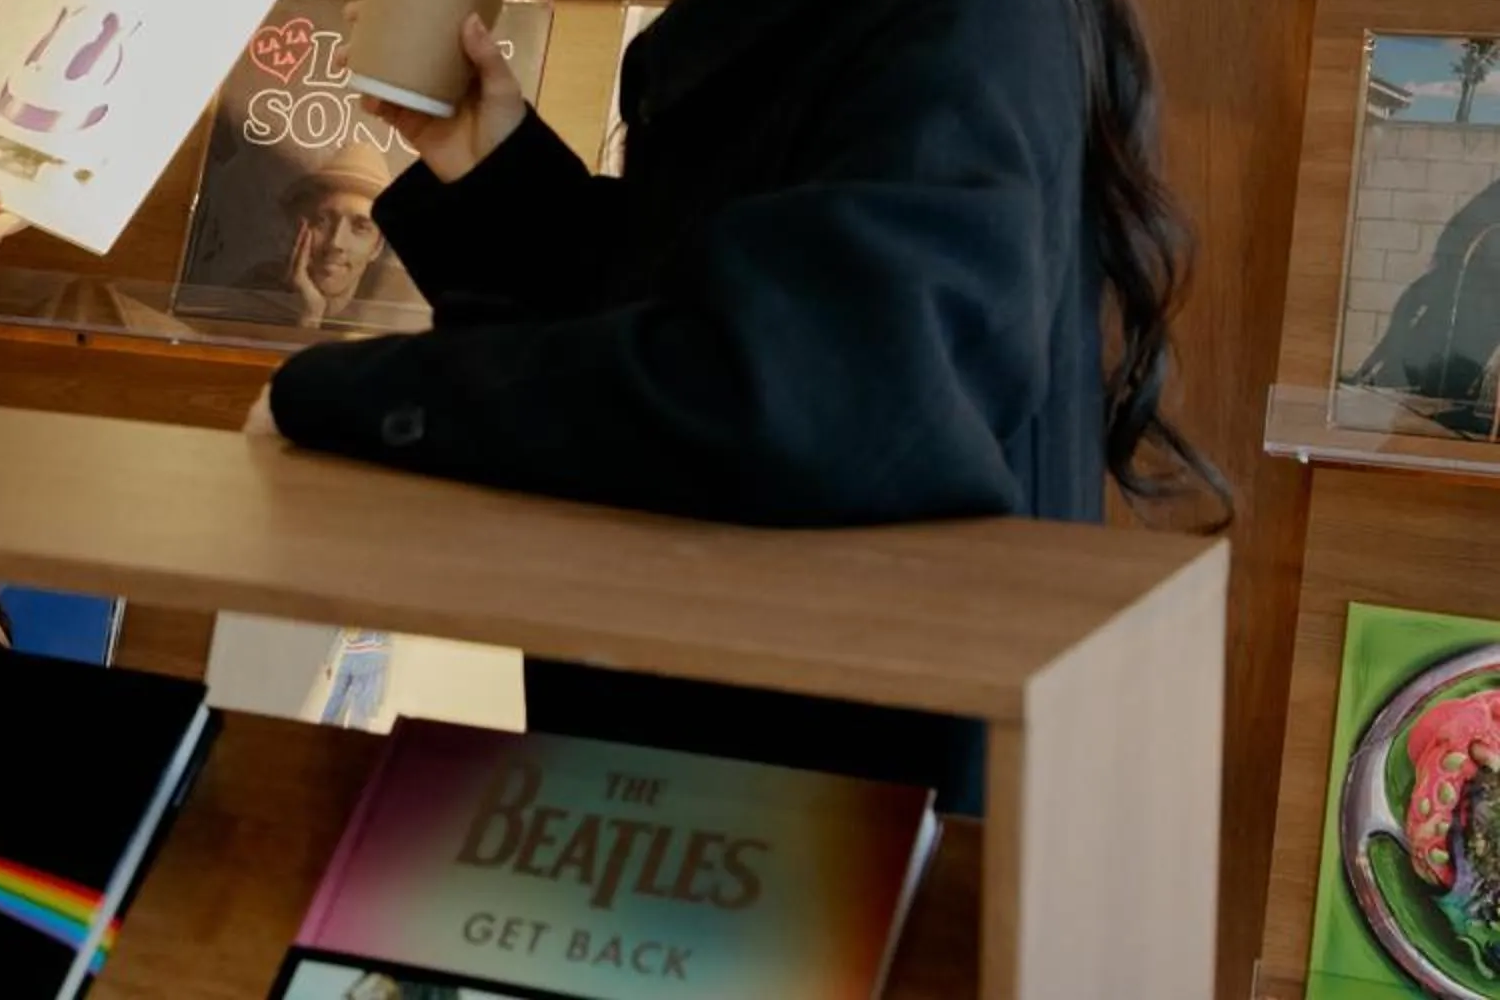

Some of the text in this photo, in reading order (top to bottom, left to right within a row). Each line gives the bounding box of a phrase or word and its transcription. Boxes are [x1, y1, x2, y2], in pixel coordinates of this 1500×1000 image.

[256, 29, 309, 54] LA LA
[272, 51, 296, 66] LA
[606, 770, 669, 807] THE
[454, 760, 773, 912] BEATLES
[462, 911, 694, 981] GET BACK
